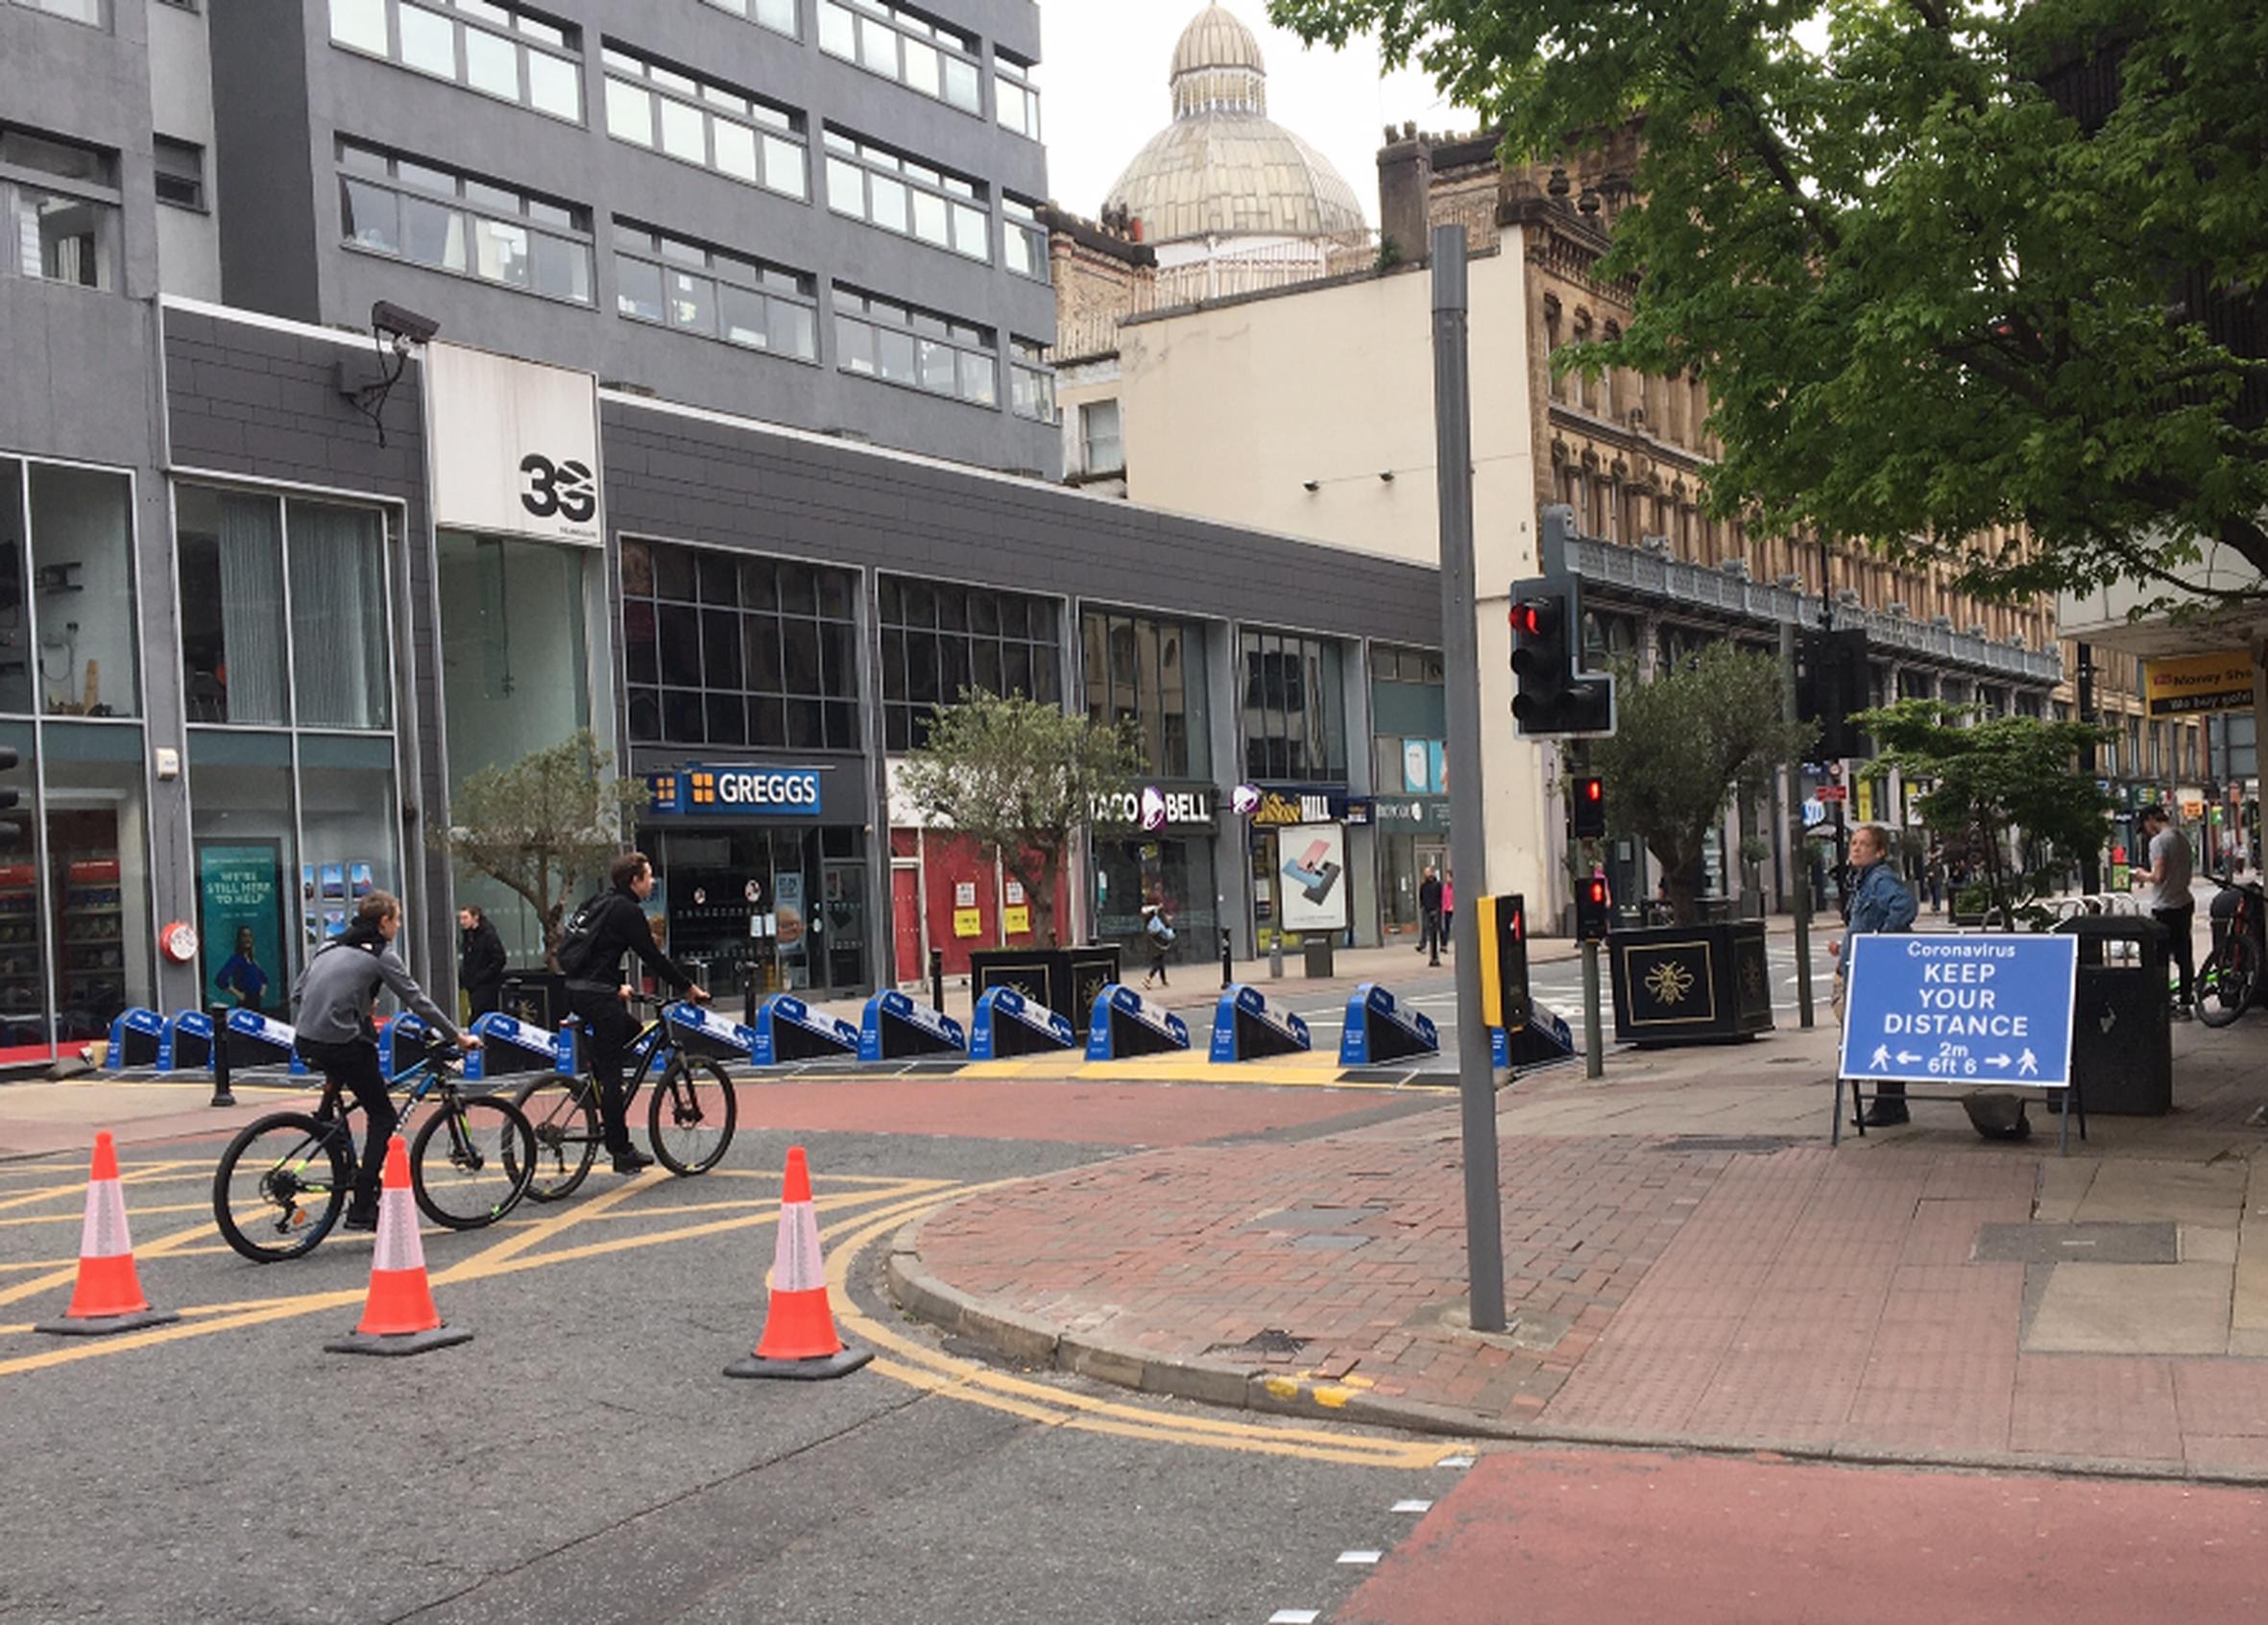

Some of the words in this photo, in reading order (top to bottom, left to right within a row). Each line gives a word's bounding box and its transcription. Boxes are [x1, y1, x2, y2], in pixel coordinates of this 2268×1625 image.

[719, 773, 815, 804] GREGGS
[1166, 793, 1210, 822] BELL
[1301, 795, 1331, 822] HILL
[206, 883, 239, 894] STILL
[215, 894, 232, 905] TO
[1907, 941, 2015, 958] Coronavirus
[1924, 963, 1995, 983] KEEP
[1919, 988, 1995, 1009] YOUR
[1884, 1014, 2029, 1037] DISTANCE
[1940, 1042, 1967, 1057] 2m
[1927, 1056, 1957, 1074] 6ft
[1964, 1060, 1977, 1075] 6
